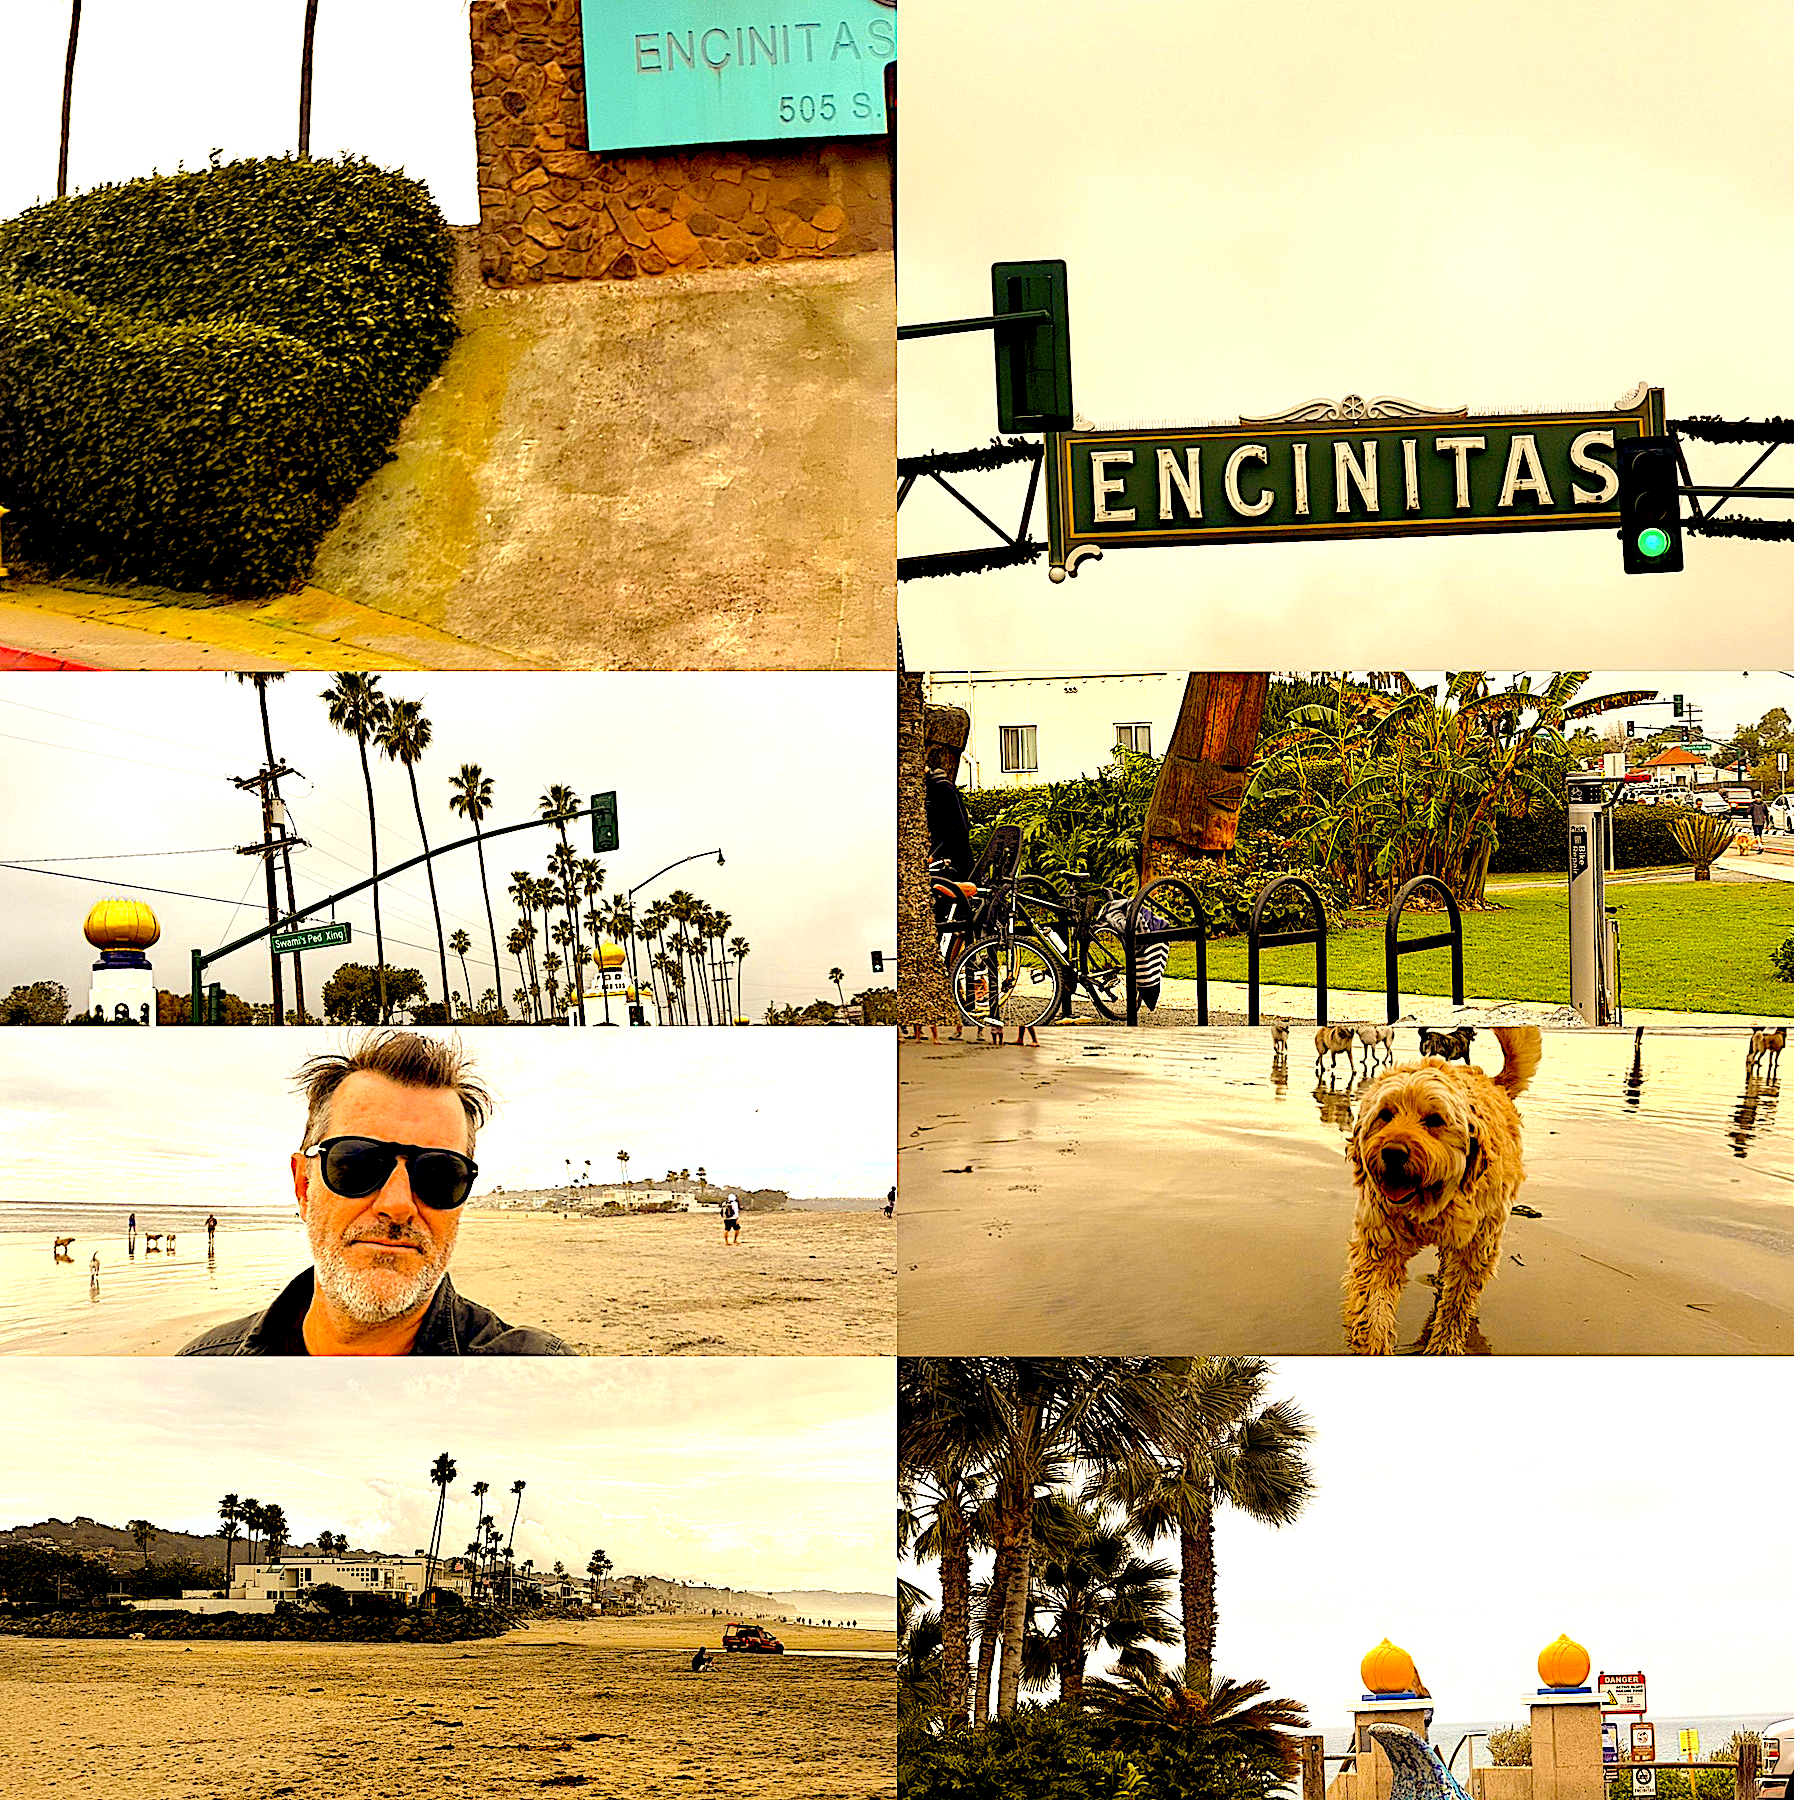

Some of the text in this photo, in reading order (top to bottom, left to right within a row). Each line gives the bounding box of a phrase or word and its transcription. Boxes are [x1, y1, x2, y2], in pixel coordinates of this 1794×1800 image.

[635, 19, 895, 74] ENCINITAS
[779, 92, 882, 123] 505 S.
[1089, 428, 1621, 524] ENCINITAS
[1578, 846, 1586, 866] Bike
[274, 930, 344, 948] Swami's Ped Xing
